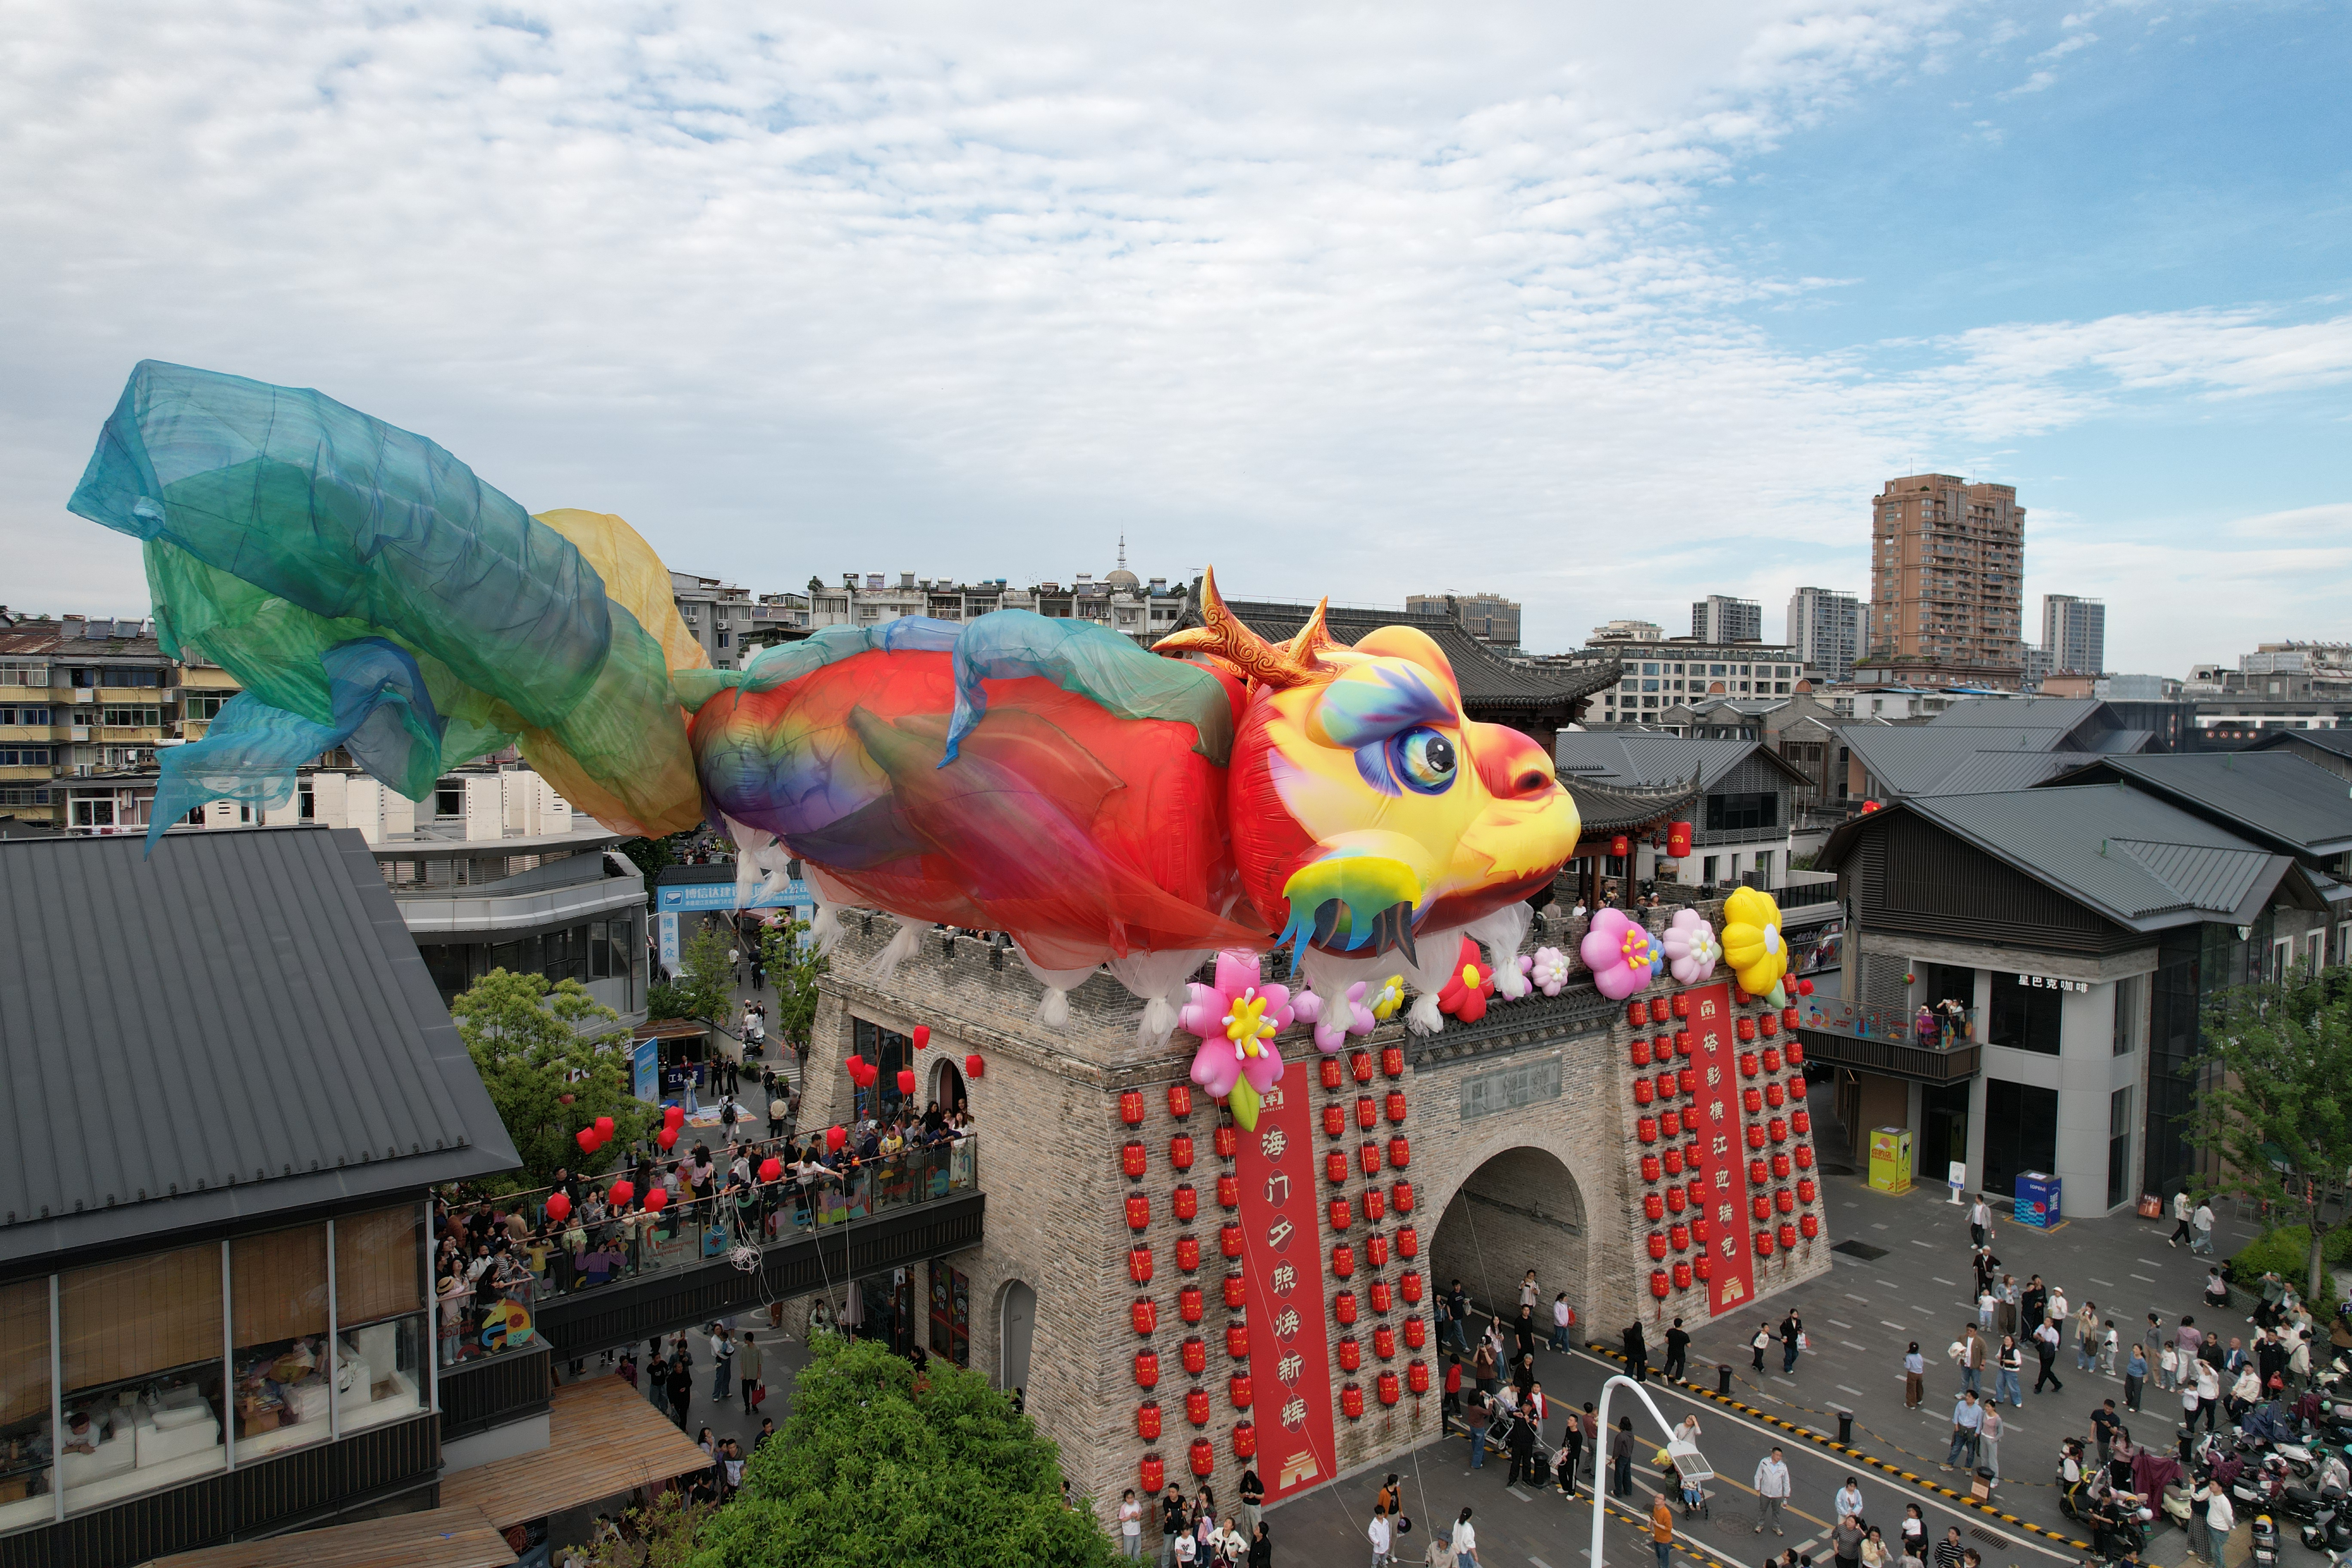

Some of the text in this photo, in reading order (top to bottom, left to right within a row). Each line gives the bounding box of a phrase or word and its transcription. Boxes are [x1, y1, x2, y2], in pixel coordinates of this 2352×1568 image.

[663, 918, 675, 959] 博采众
[2018, 975, 2088, 993] 星巴克咖啡
[1703, 1032, 1736, 1257] 塔影横江迎瑞气
[1262, 1130, 1307, 1425] 海门夕照焕新辉
